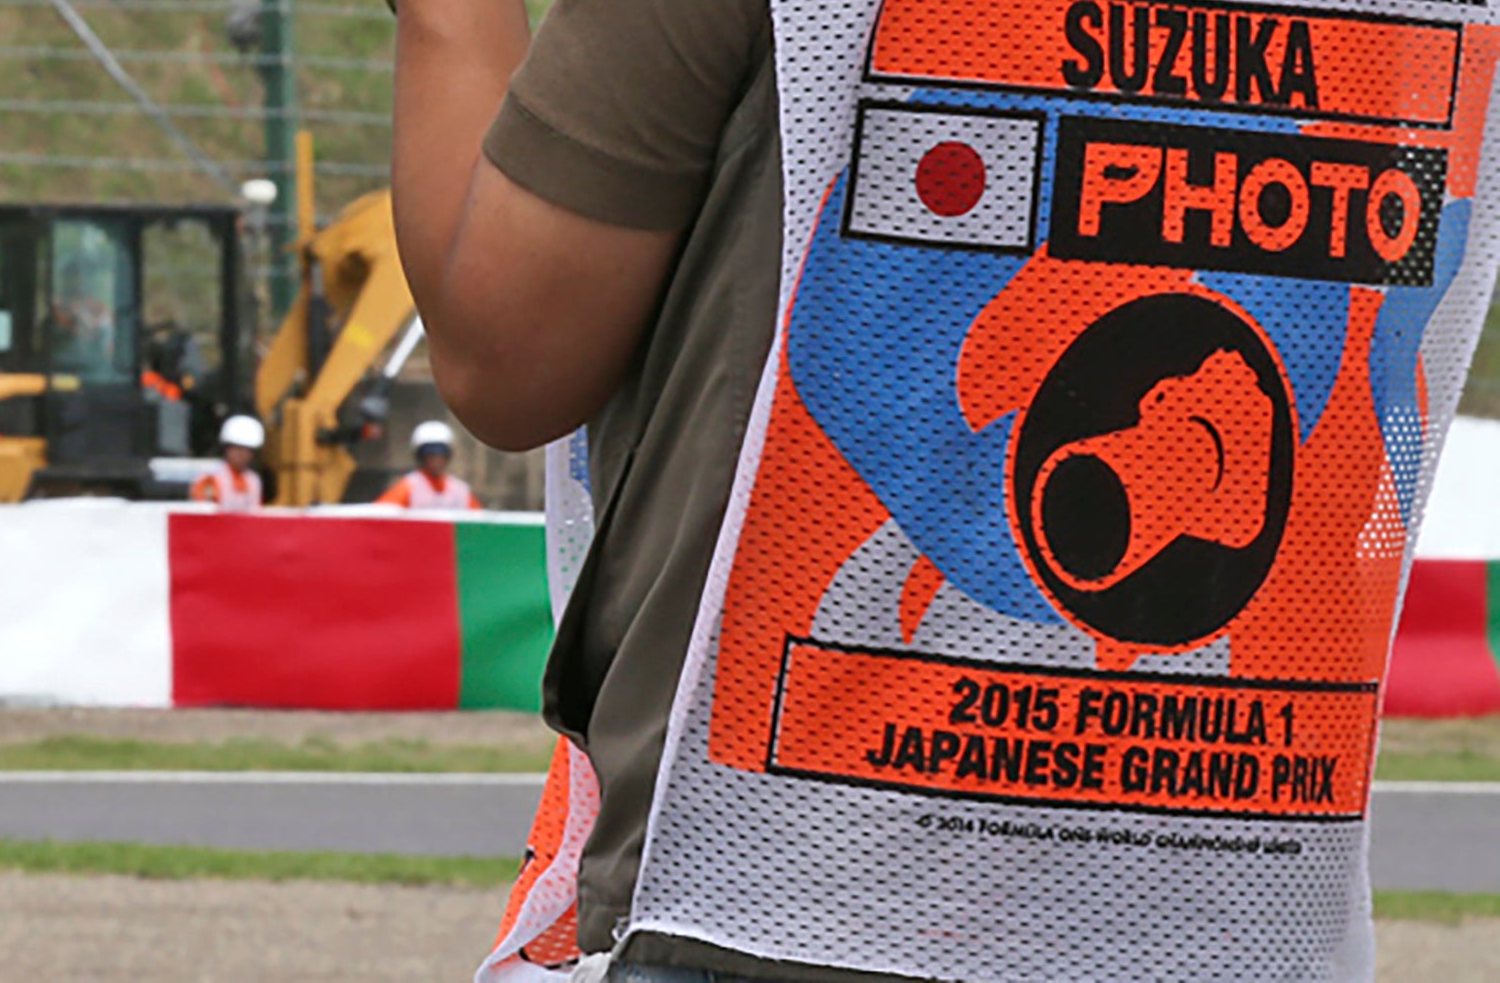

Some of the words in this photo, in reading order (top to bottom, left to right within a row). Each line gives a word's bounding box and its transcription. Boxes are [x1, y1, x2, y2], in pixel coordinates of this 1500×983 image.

[1062, 0, 1321, 111] SUZUKA
[1078, 142, 1422, 262] PHOTO
[950, 676, 1060, 732] 2015
[1075, 688, 1267, 746] FORMULA
[1280, 701, 1294, 747] 1
[867, 722, 1107, 789] JAPANESE
[1120, 745, 1260, 799] GRAND
[1272, 753, 1337, 805] PRIX
